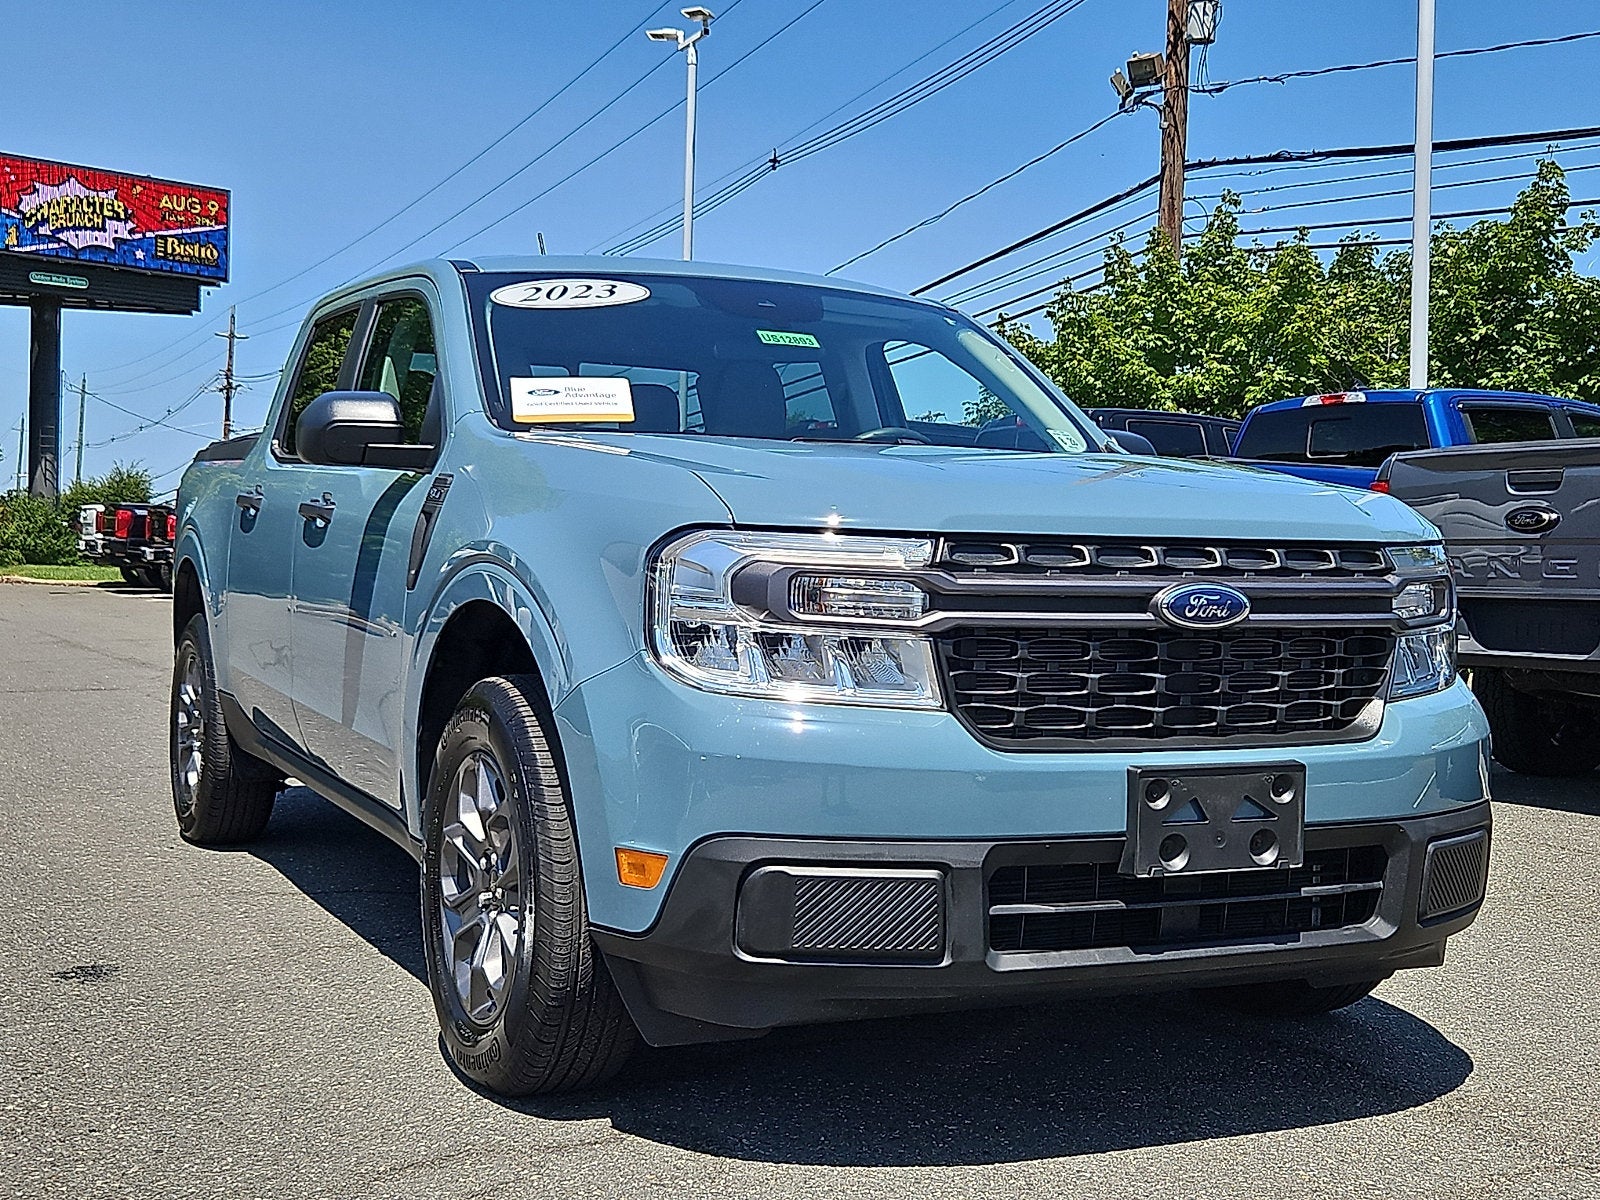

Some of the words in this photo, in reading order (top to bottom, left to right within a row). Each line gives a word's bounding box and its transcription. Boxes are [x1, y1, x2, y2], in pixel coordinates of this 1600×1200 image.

[25, 196, 125, 229] CHARACTER
[159, 194, 202, 214] AUG
[207, 200, 220, 216] 9
[49, 212, 103, 231] BRUNCH
[519, 284, 618, 302] 2023
[1514, 513, 1538, 525] Ford
[1185, 594, 1232, 617] Ford
